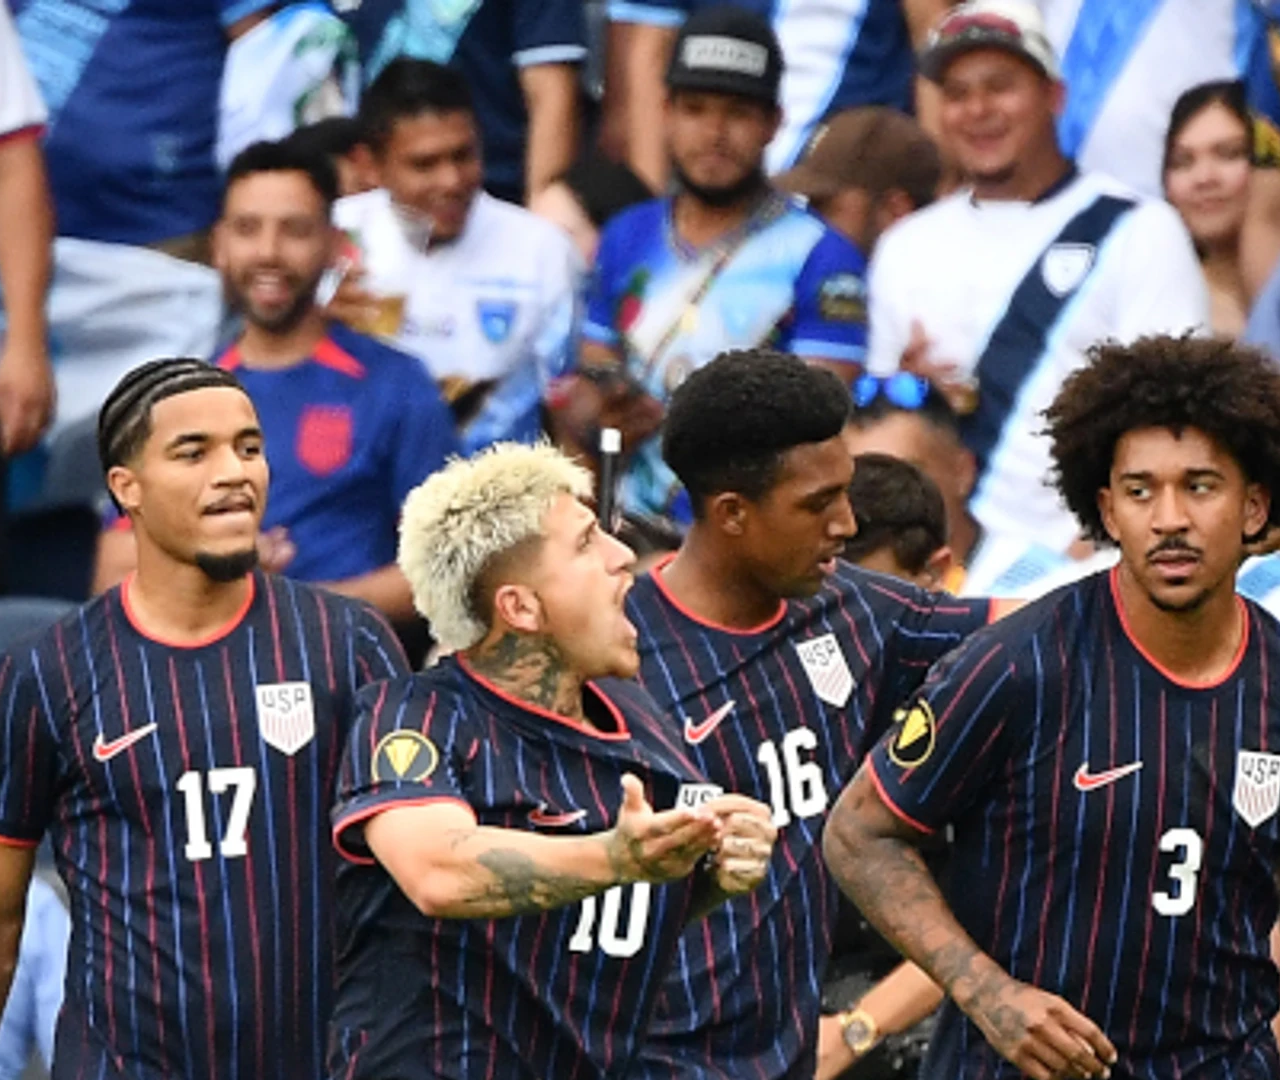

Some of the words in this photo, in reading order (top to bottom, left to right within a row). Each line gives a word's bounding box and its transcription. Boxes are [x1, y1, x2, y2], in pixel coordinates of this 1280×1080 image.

[261, 686, 306, 714] USA
[758, 726, 829, 828] 16
[1241, 756, 1280, 785] USA
[176, 766, 257, 861] 17
[1151, 827, 1204, 917] 3
[570, 881, 651, 957] 10
